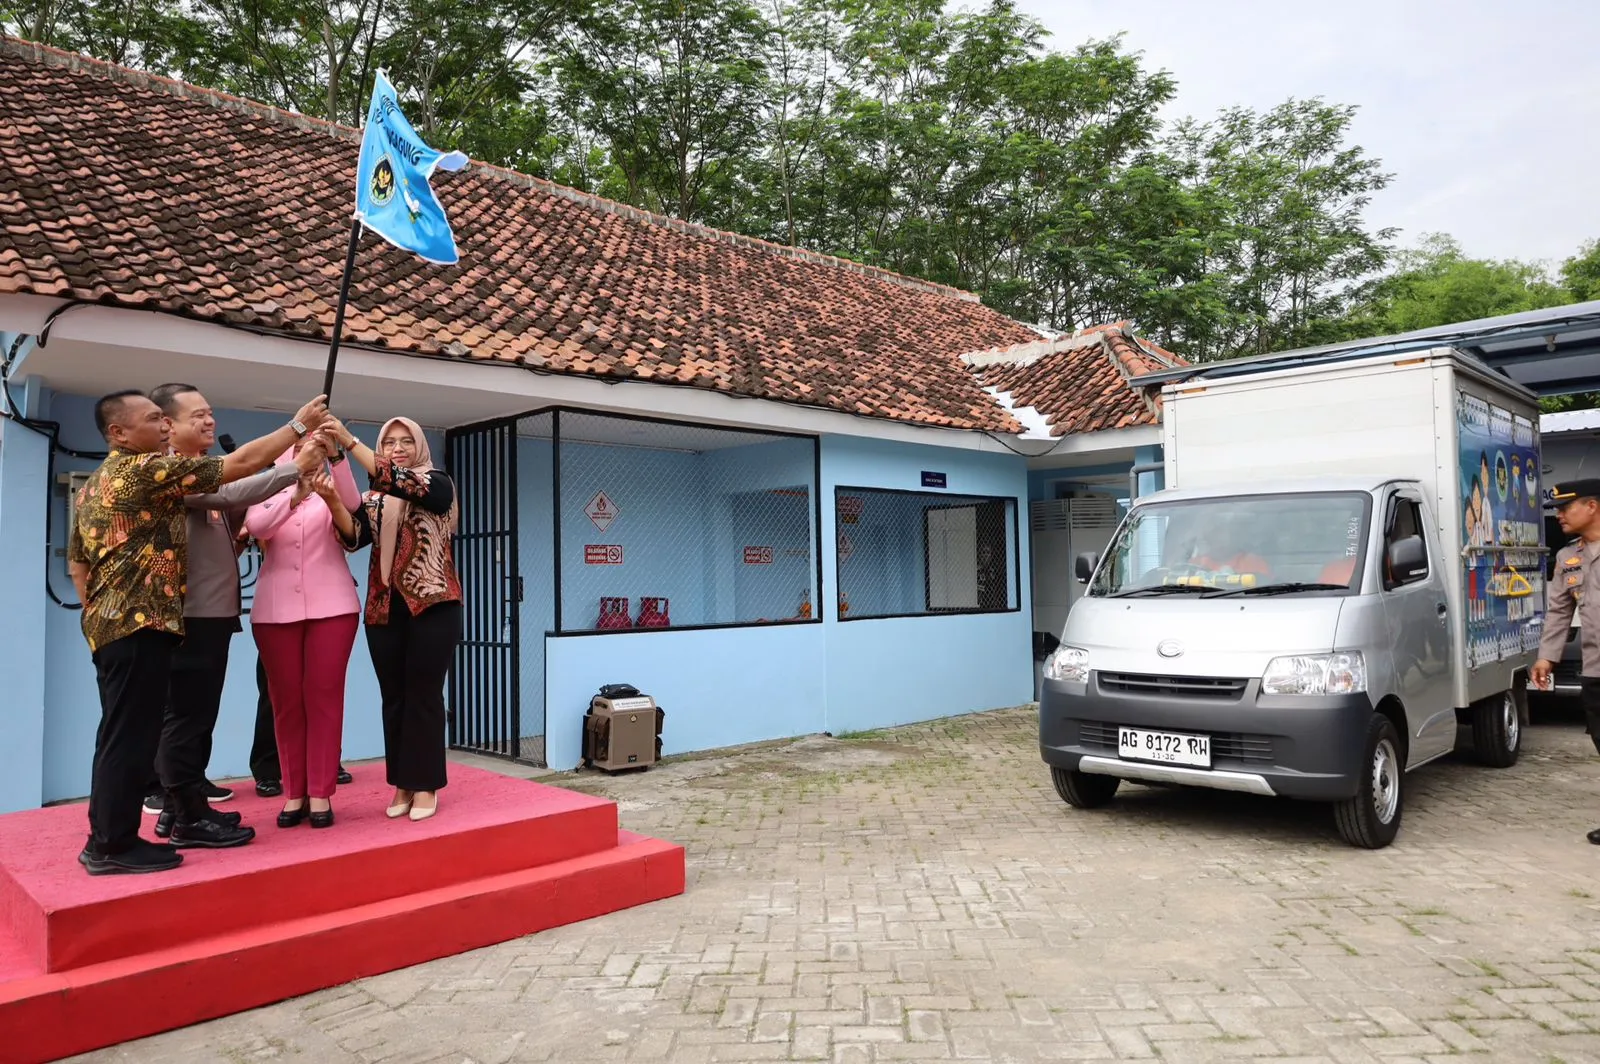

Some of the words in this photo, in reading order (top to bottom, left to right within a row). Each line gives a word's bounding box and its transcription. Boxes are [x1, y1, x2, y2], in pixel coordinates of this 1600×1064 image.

[1121, 731, 1138, 748] AG
[1146, 734, 1181, 753] 8172
[1187, 738, 1207, 755] RW
